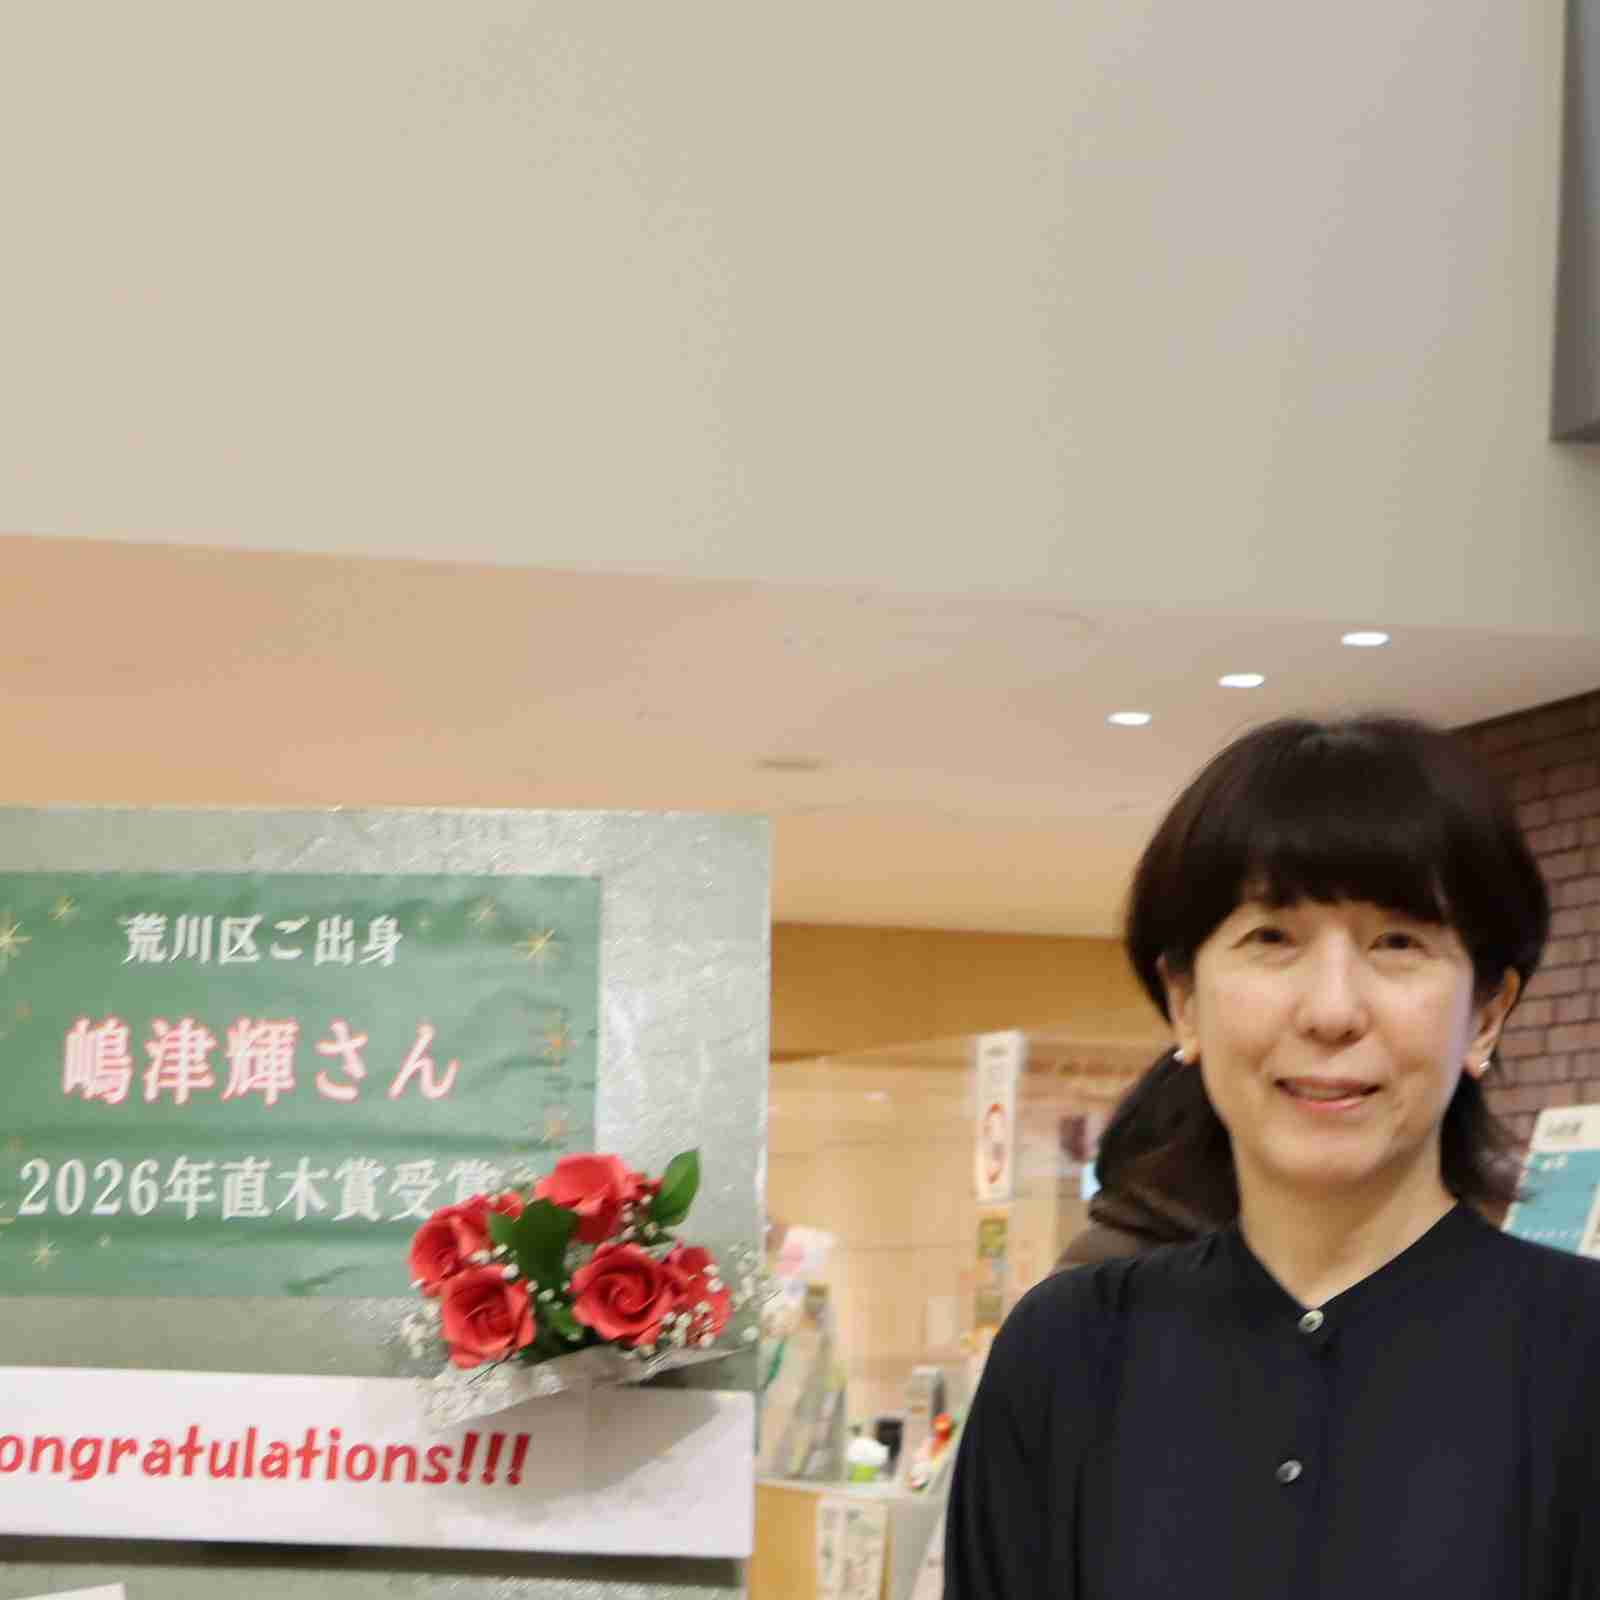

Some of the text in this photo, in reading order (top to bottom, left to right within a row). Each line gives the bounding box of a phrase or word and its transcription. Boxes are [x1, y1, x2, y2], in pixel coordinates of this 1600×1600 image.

[121, 913, 404, 968] 荒川区ご出身
[61, 1014, 461, 1106] 嶋津輝さん
